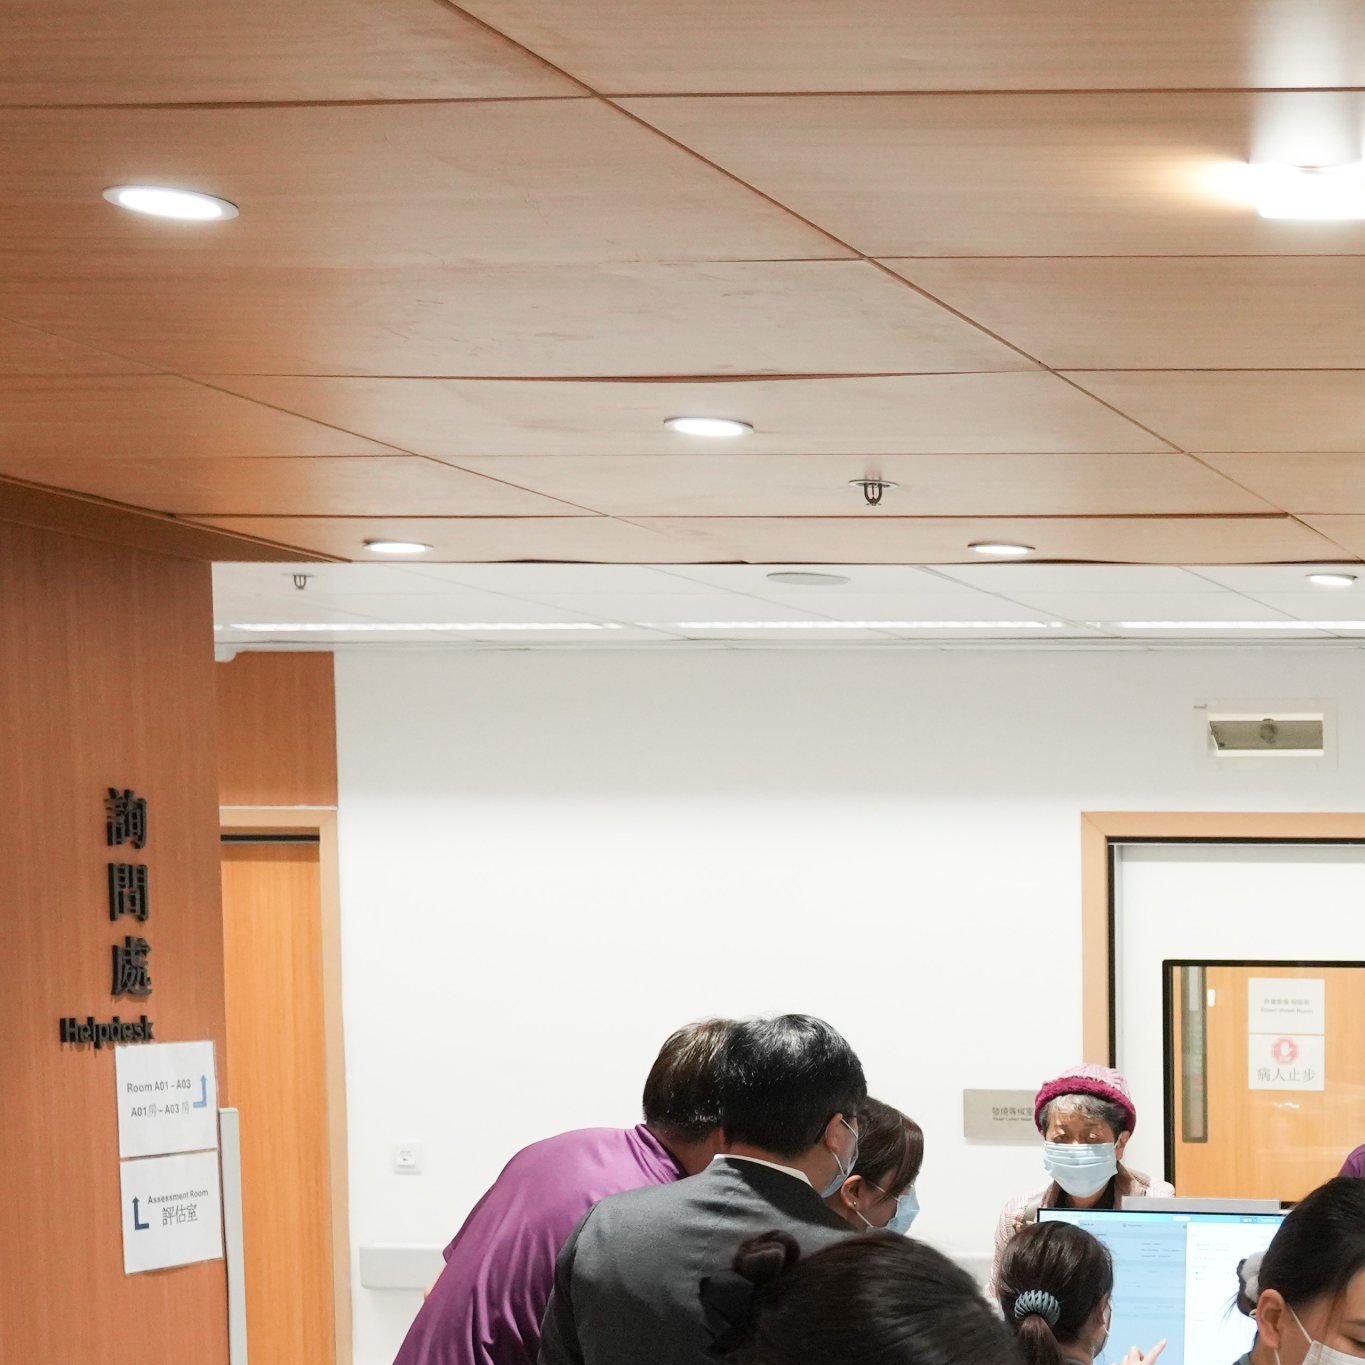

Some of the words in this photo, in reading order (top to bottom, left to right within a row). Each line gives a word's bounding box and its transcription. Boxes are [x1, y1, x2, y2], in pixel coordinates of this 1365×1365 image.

[103, 787, 153, 997] 詢問處
[60, 1015, 154, 1049] Helpdesk
[1258, 1067, 1316, 1082] 病人止步
[127, 1082, 153, 1093] Room
[154, 1080, 169, 1091] A01
[176, 1079, 191, 1089] A03
[147, 1191, 189, 1205] Assessment
[189, 1189, 209, 1199] Room
[162, 1203, 198, 1226] 評估室
